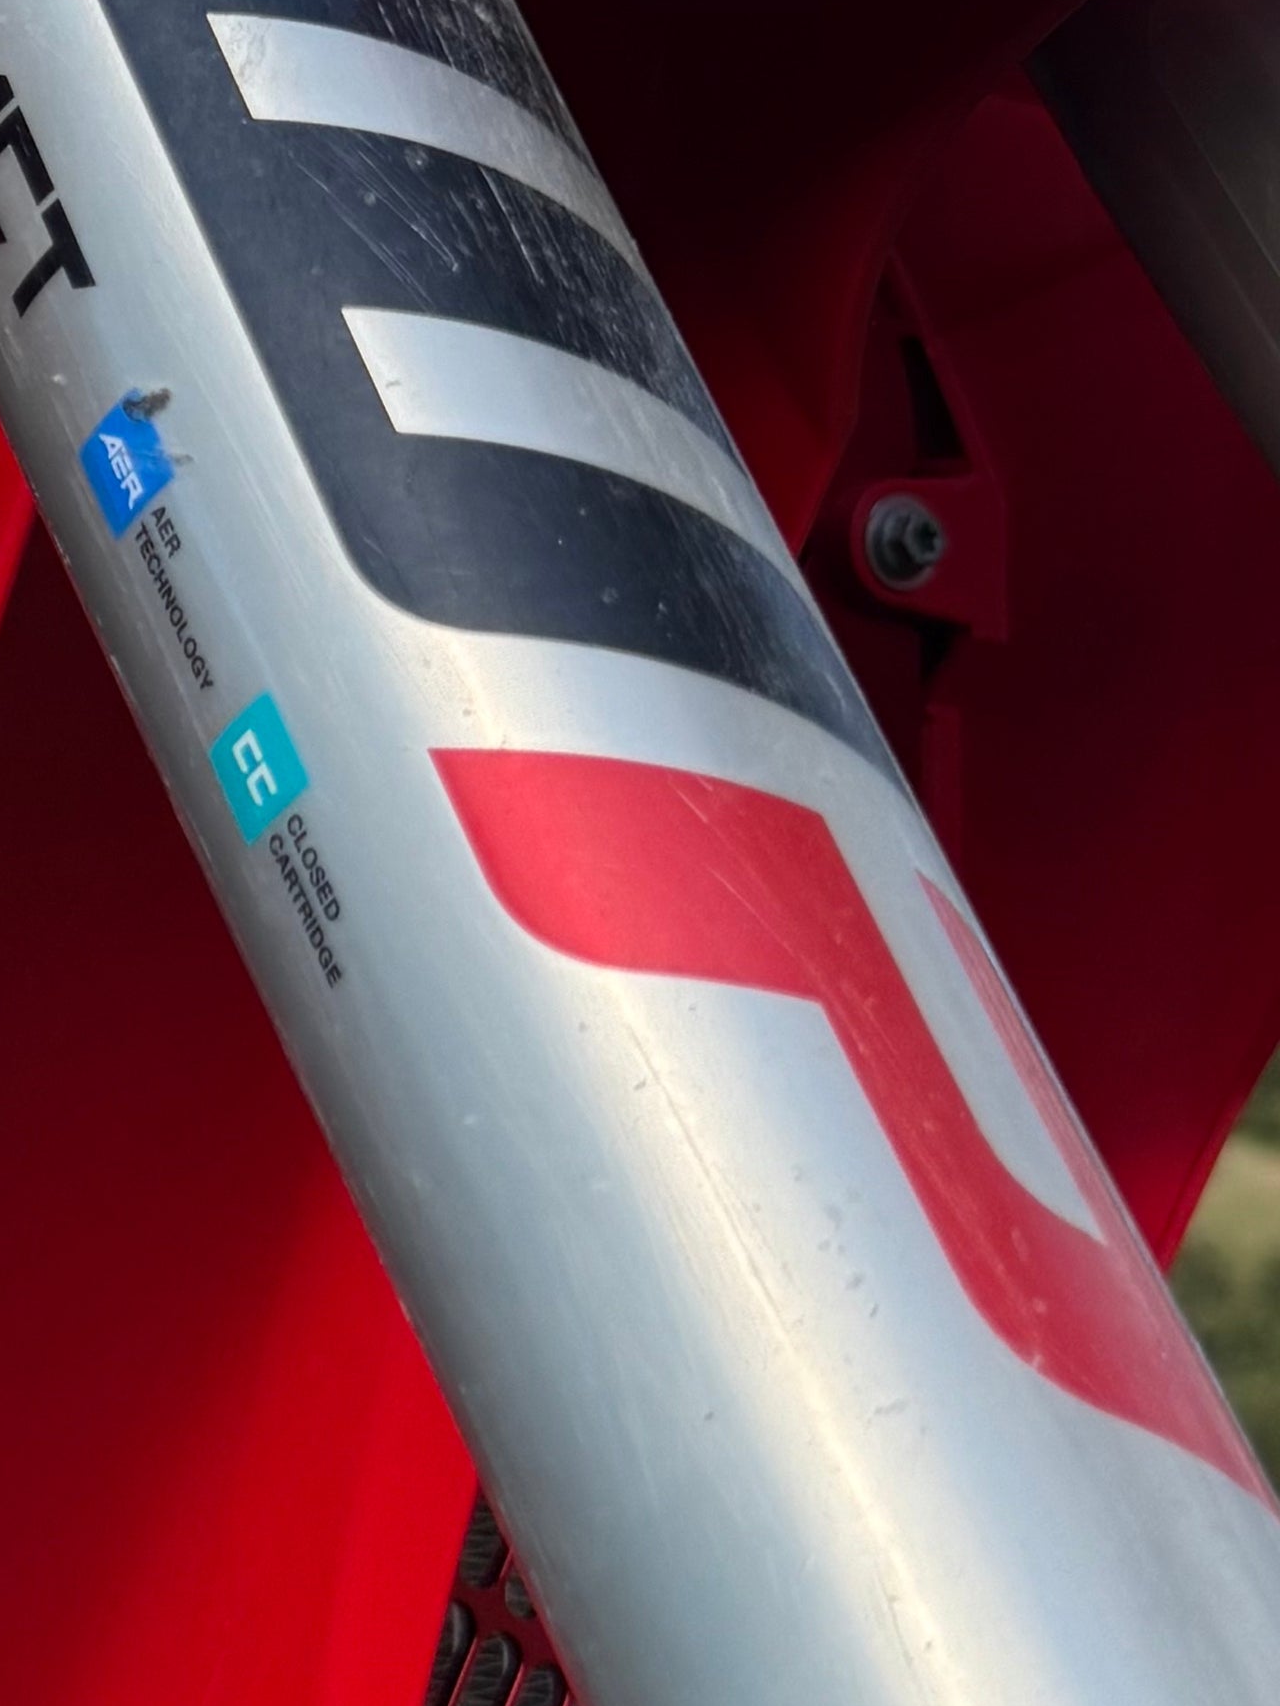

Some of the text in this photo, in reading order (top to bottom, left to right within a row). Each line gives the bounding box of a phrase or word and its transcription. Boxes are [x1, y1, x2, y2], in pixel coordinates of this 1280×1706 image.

[97, 432, 143, 511] AER
[150, 505, 182, 559] AER
[134, 524, 215, 692] TECHNOLOGY
[231, 729, 278, 807] CC
[269, 834, 342, 989] CARTRIDGE
[286, 814, 341, 923] CLOSED
